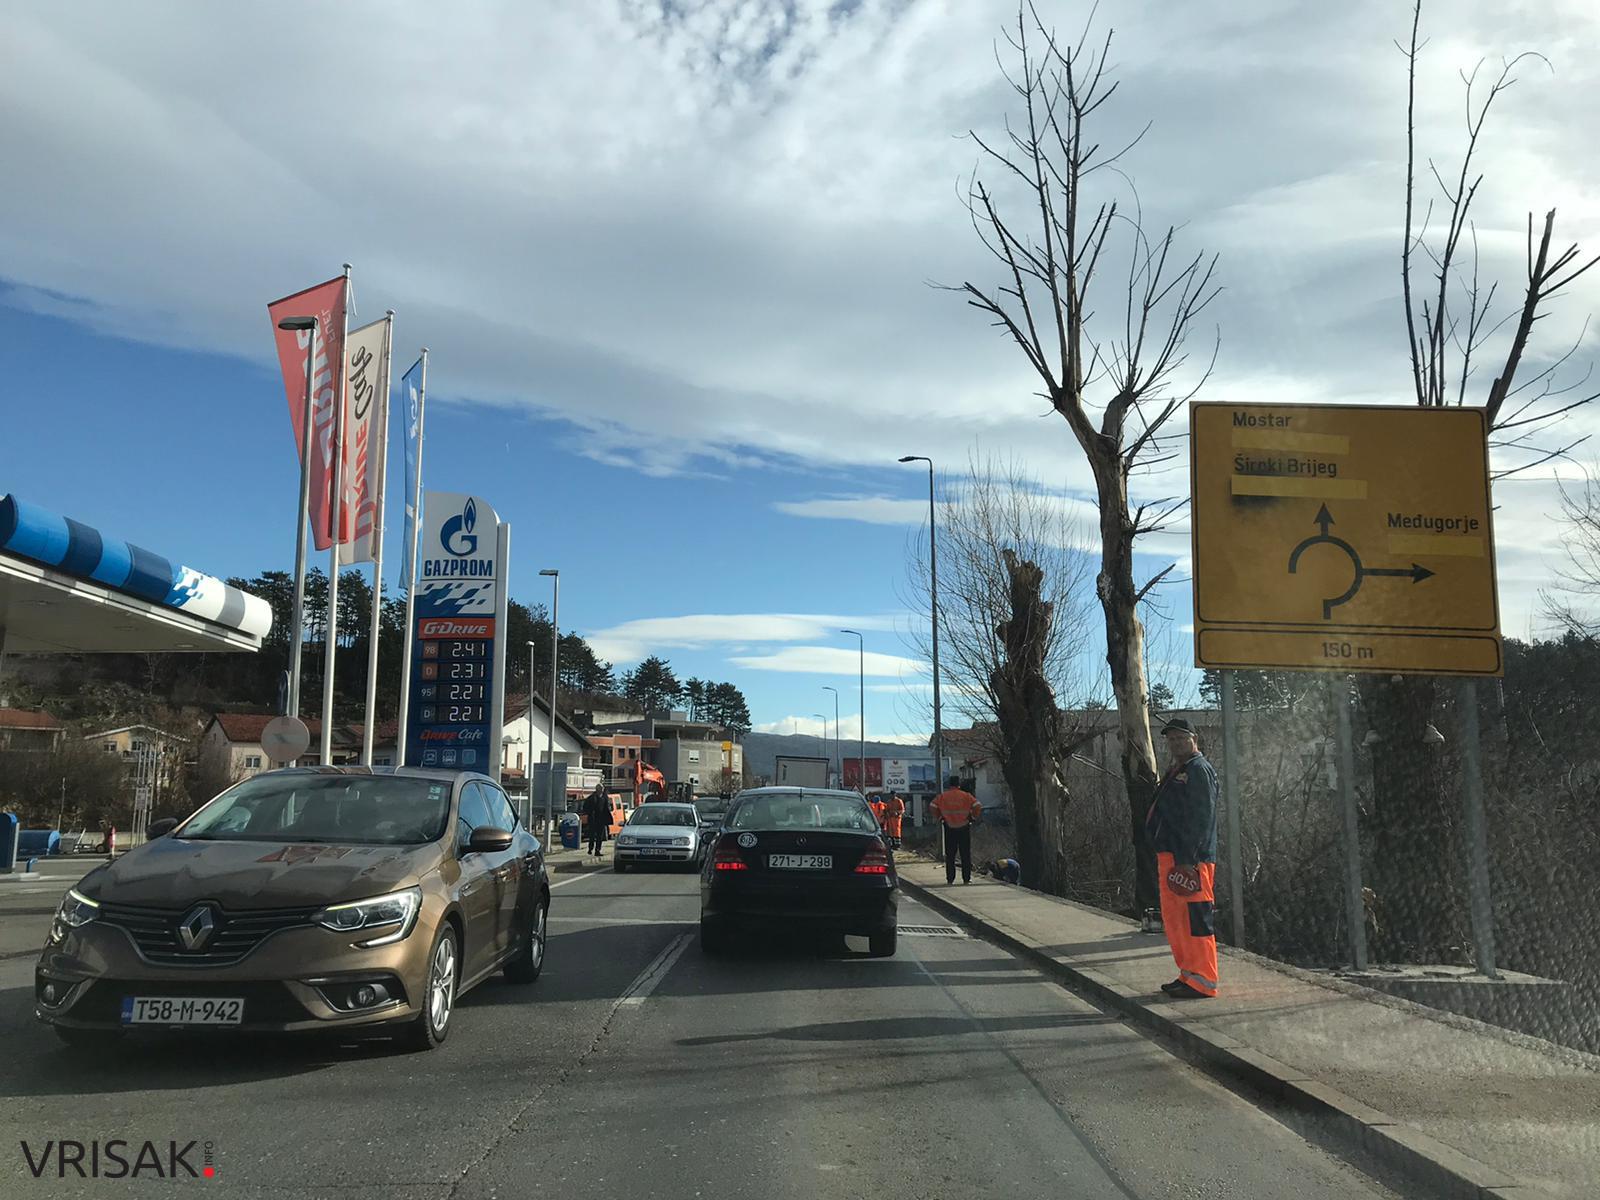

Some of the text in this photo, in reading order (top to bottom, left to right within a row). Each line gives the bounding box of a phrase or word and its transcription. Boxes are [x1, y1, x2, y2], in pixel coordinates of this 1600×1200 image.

[1232, 411, 1292, 428] Mostar
[1287, 458, 1337, 478] Brijeg
[424, 559, 493, 577] GAZPROM
[452, 642, 485, 657] 2.41
[1322, 642, 1374, 659] 150 m
[451, 663, 484, 679] 2.31
[450, 684, 483, 700] 2.21
[449, 706, 482, 721] 2.21
[771, 855, 831, 868] 271-J-298
[1168, 871, 1198, 892] STOP
[136, 999, 240, 1021] T58-M-942
